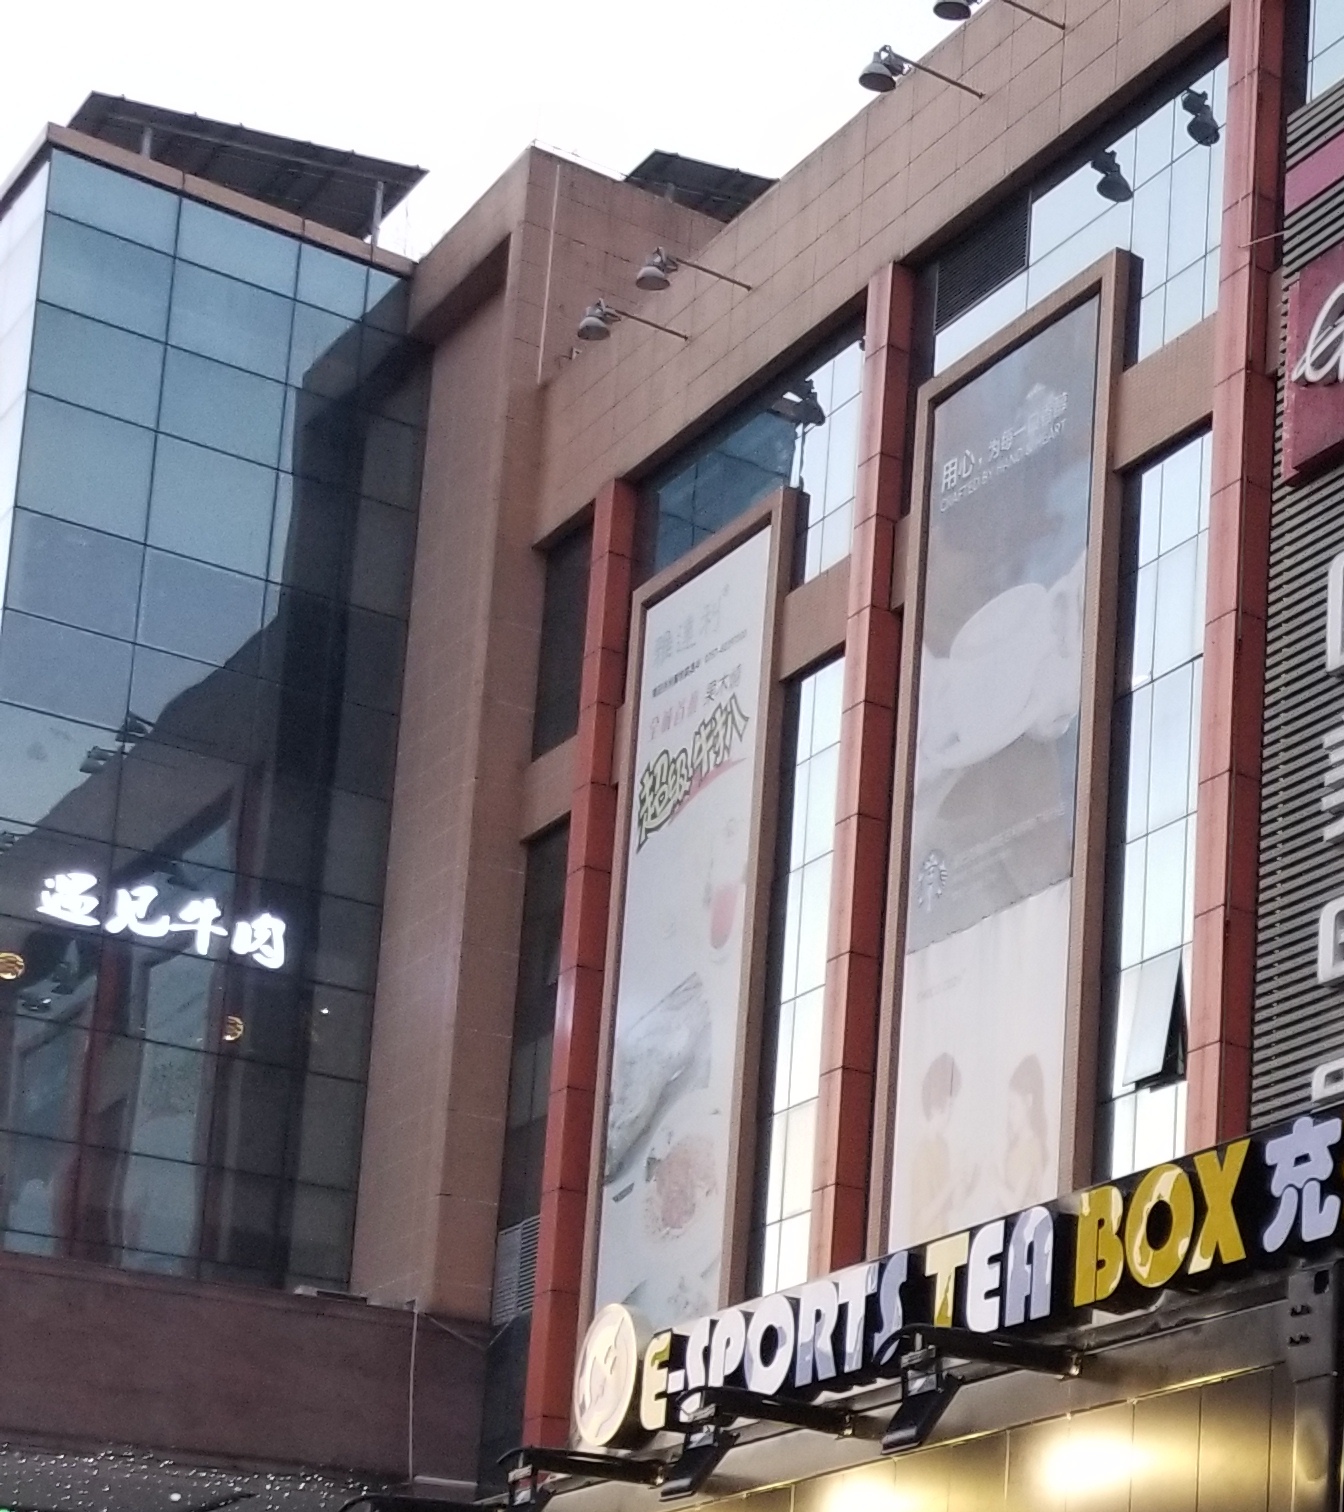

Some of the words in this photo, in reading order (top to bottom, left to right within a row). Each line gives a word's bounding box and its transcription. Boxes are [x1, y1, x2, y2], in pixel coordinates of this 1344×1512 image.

[640, 1251, 908, 1431] E-SPORTS
[925, 1206, 1054, 1332] TEA
[1073, 1139, 1250, 1309] BOX
